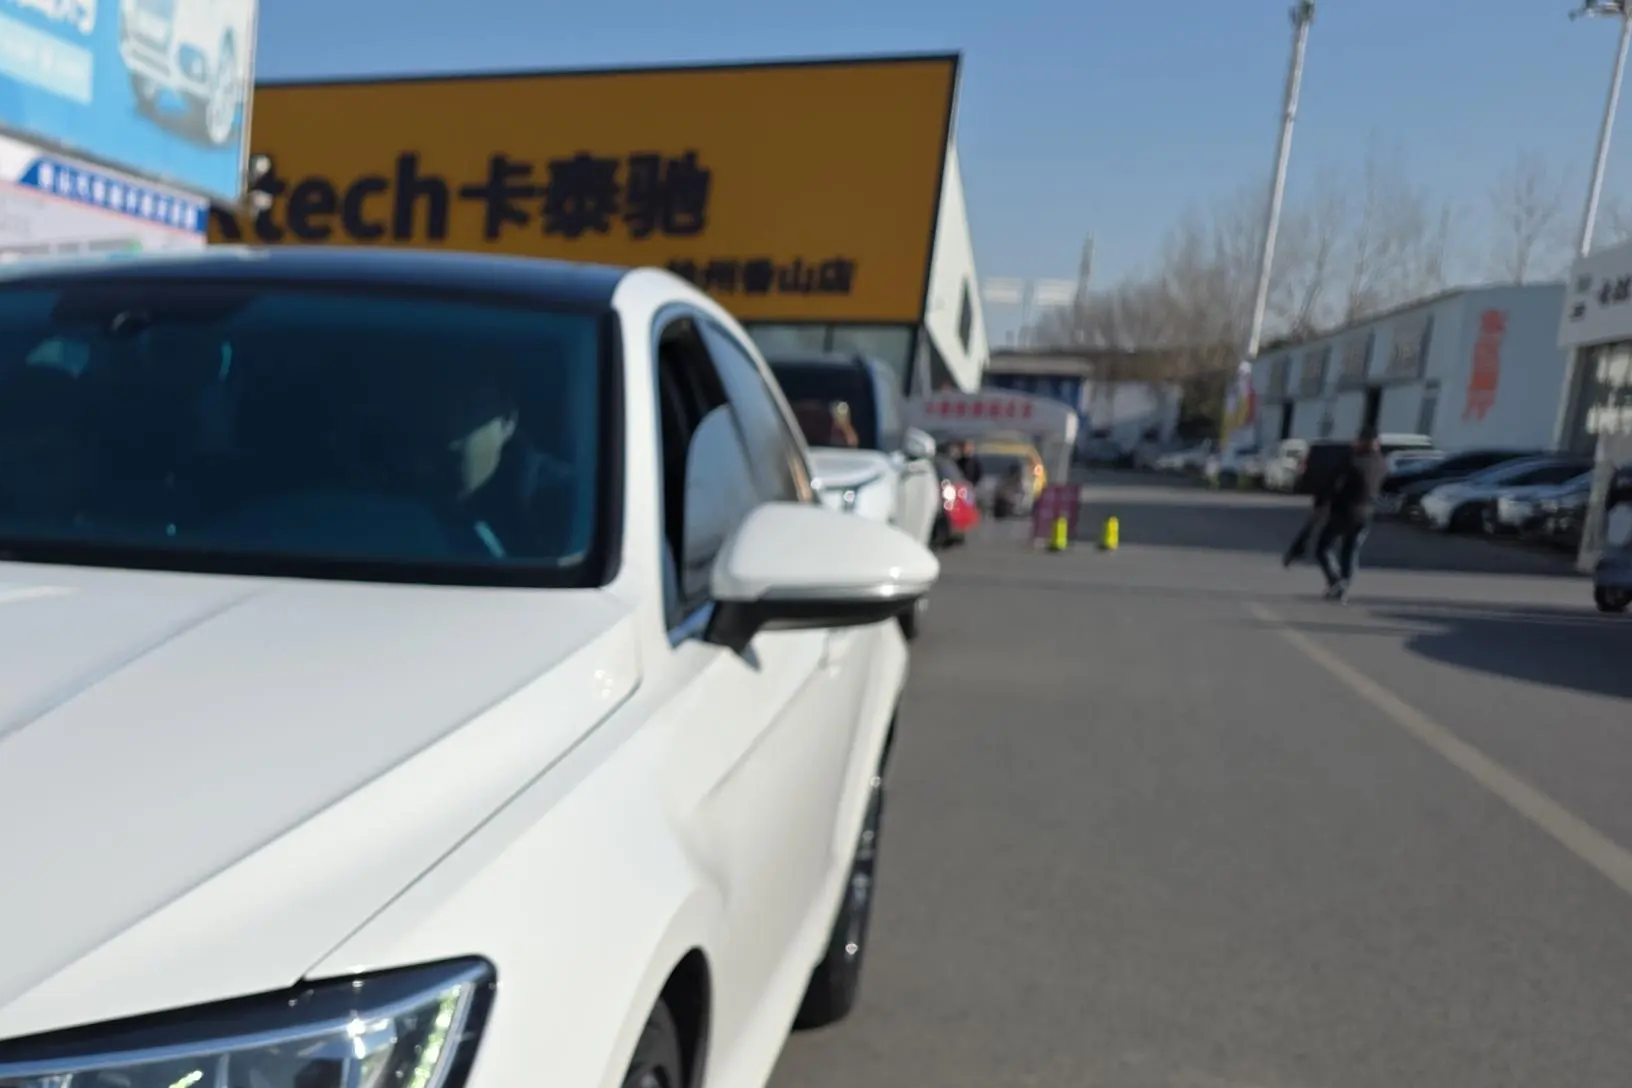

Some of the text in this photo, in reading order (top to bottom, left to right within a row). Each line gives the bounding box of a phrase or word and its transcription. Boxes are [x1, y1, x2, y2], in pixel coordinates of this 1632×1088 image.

[210, 151, 449, 240] tech
[460, 151, 712, 240] 卡泰驰
